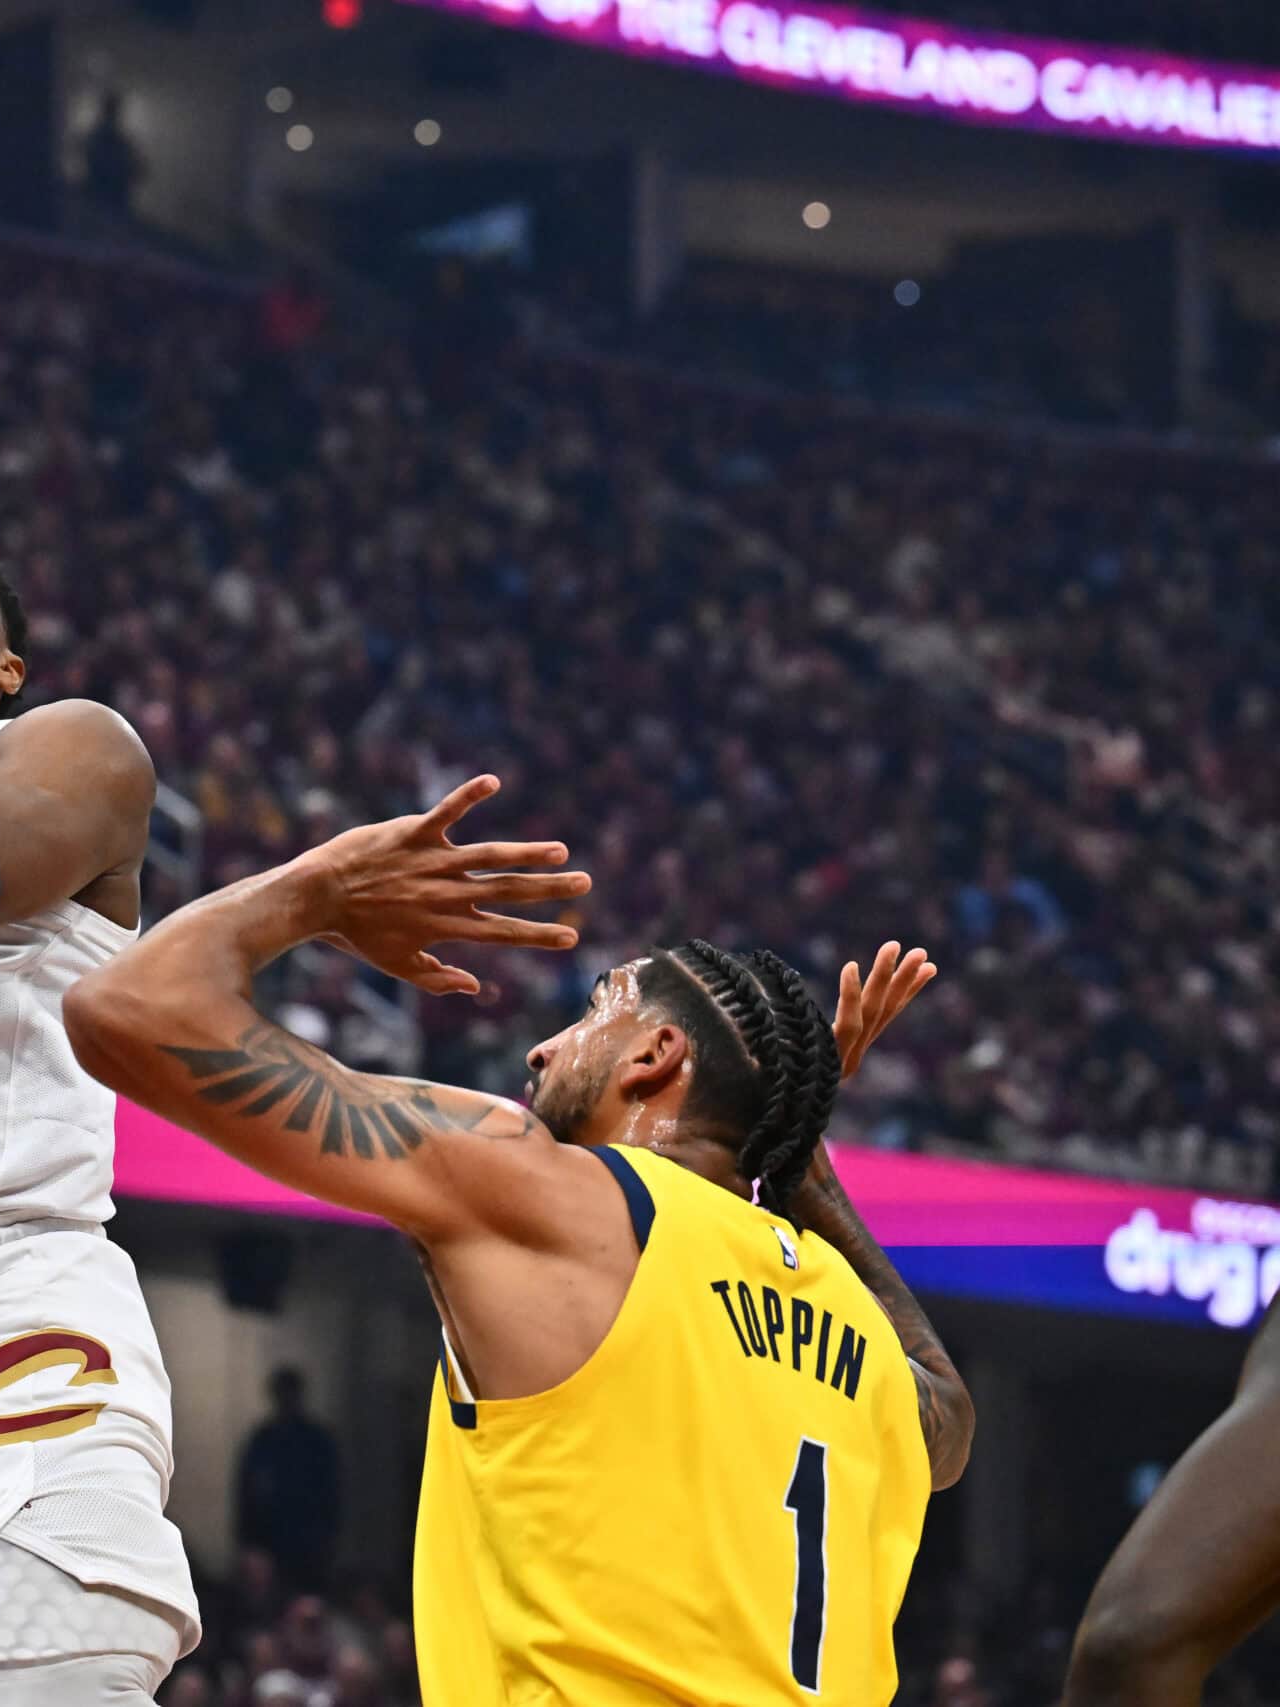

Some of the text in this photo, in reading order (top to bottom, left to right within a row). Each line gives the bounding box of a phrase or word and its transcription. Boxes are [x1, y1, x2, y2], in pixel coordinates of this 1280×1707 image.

[719, 2, 1038, 114] CLEVELAND
[710, 1279, 867, 1402] TOPPIN
[783, 1435, 827, 1696] 1
